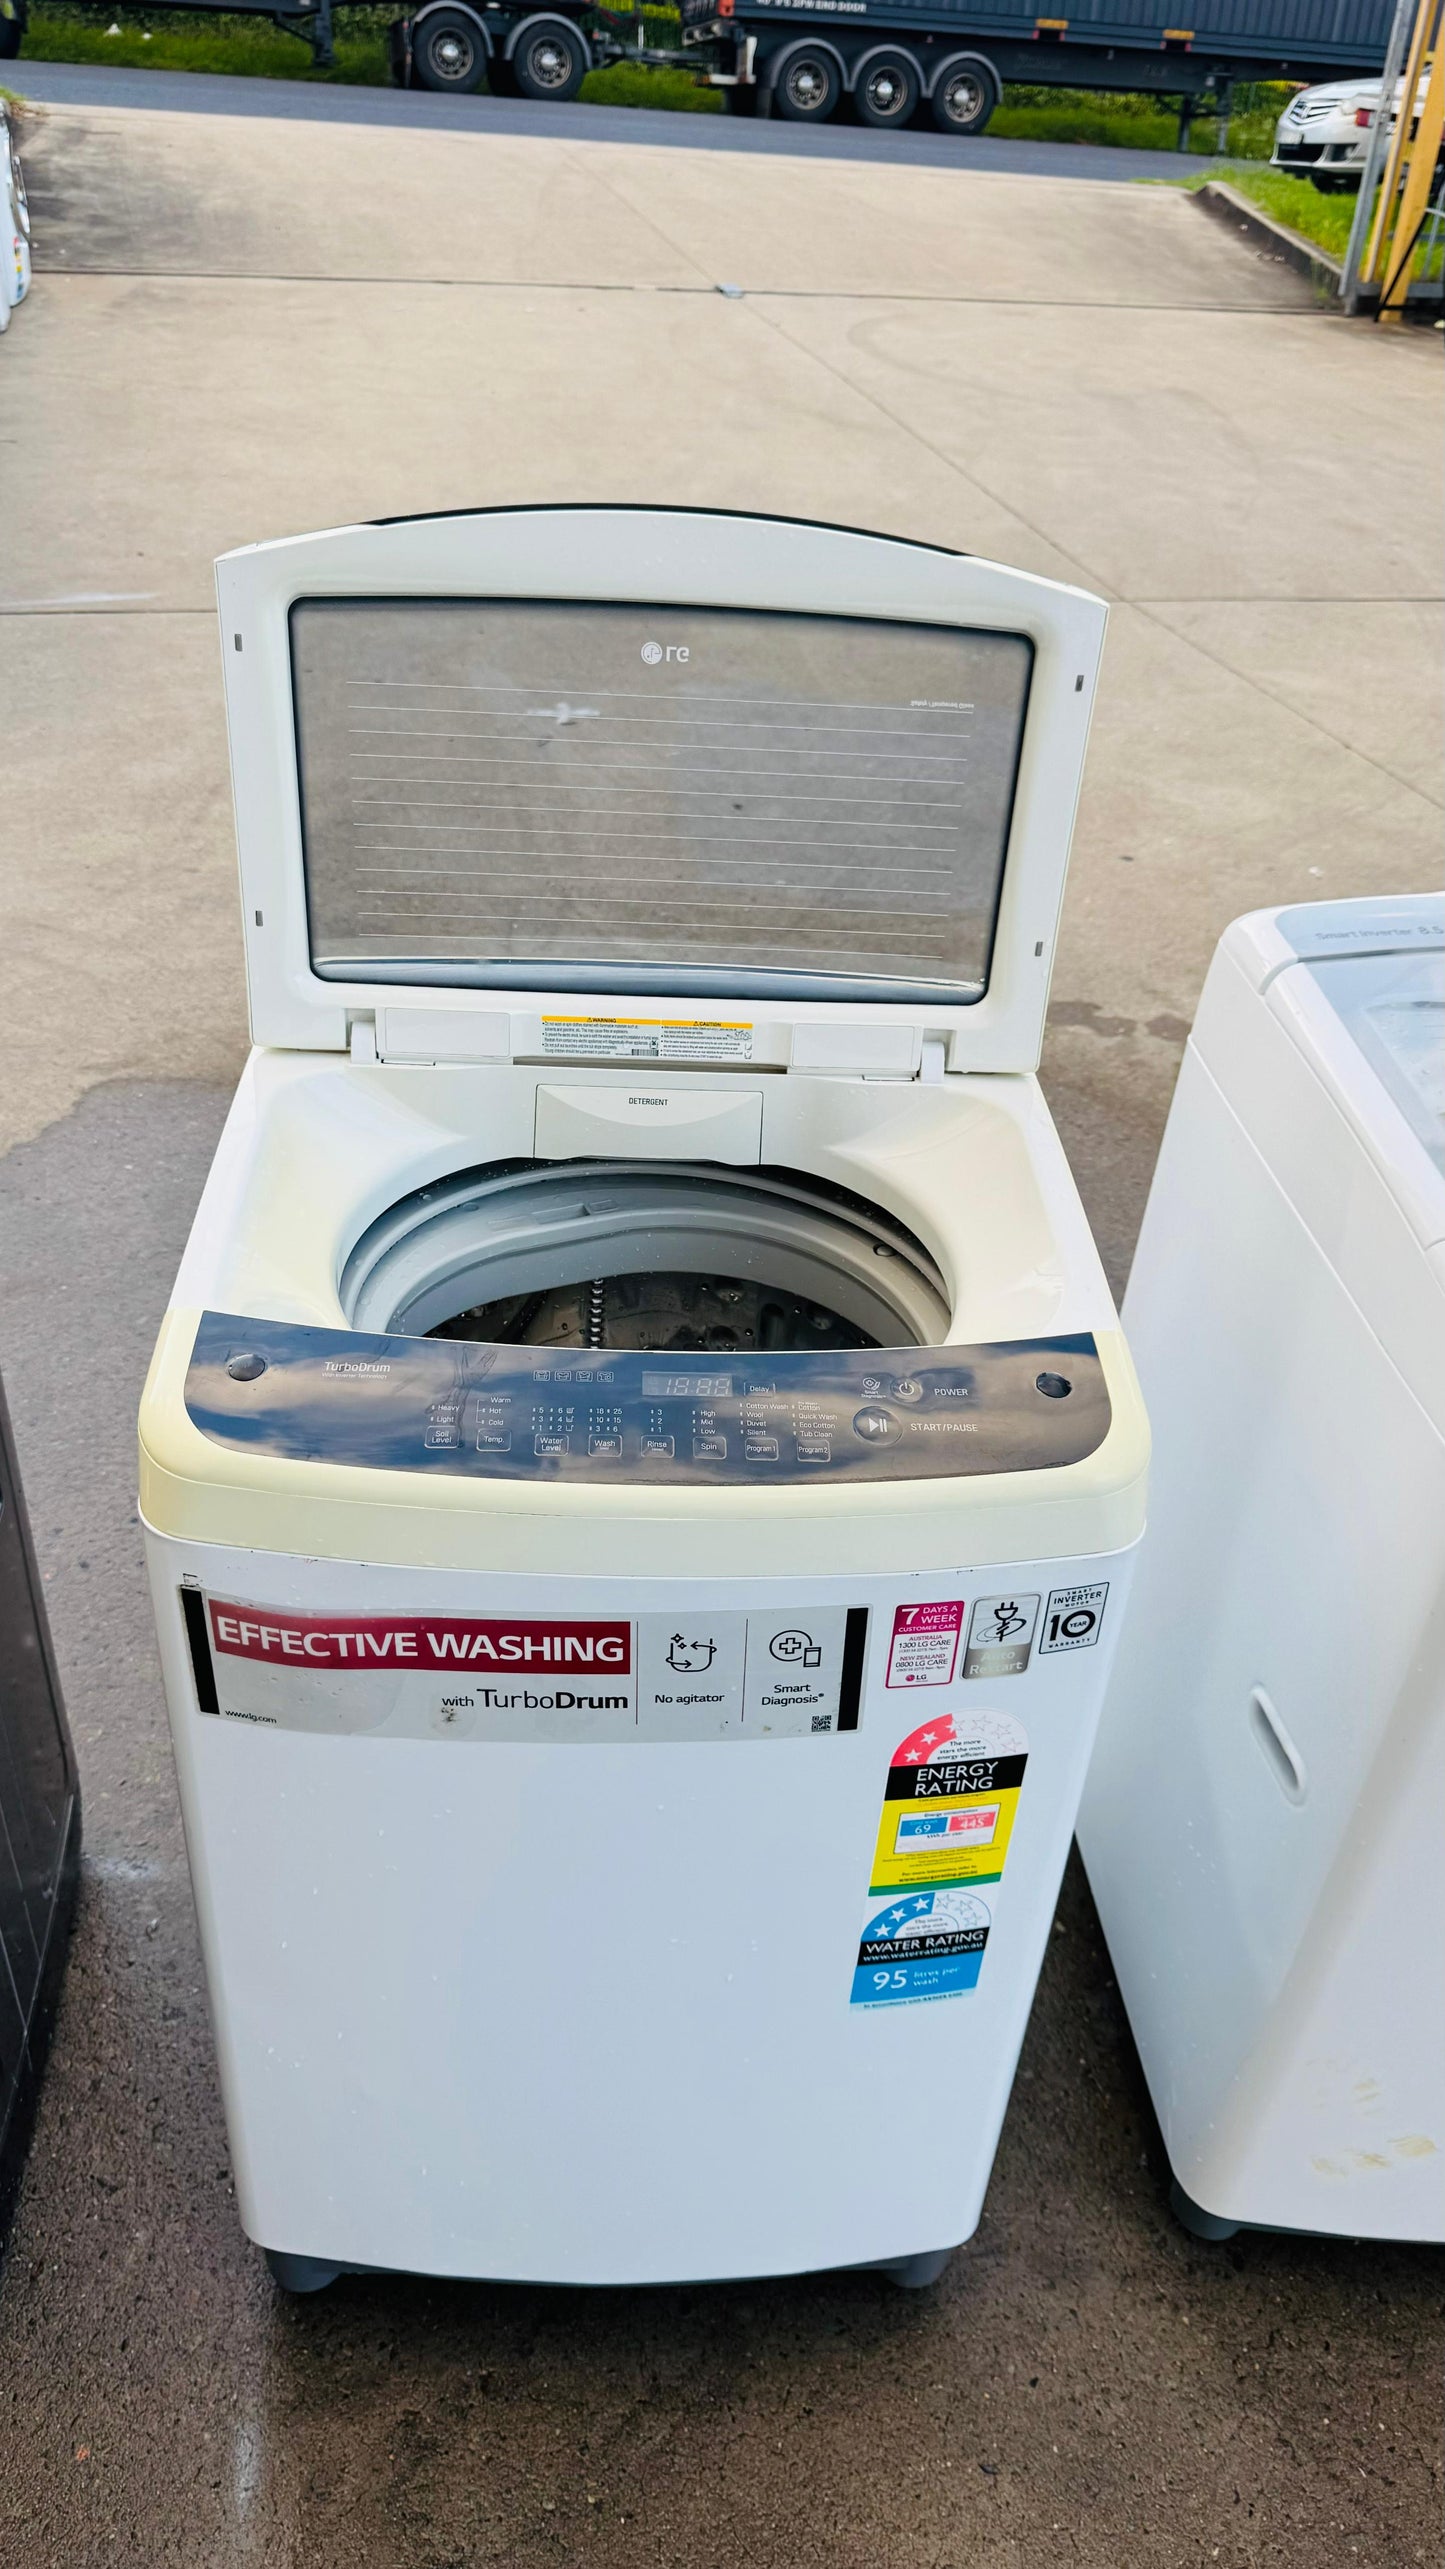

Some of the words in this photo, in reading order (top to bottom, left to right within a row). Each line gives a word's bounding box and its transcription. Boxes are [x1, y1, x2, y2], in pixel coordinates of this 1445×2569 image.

[628, 1097, 668, 1106] DETERGENT
[324, 1361, 391, 1372] TurboDrum
[749, 1385, 770, 1393] Delay
[934, 1388, 969, 1397] POWER
[798, 1403, 821, 1411] Cotton
[700, 1410, 716, 1418] High
[436, 1416, 454, 1424] Light
[799, 1421, 812, 1429] Eco
[910, 1423, 979, 1432] START/PAUSE
[431, 1436, 452, 1444] Level
[483, 1435, 505, 1444] Temp.
[647, 1440, 668, 1448] Rinse
[746, 1444, 772, 1453] Program
[798, 1446, 823, 1454] Program
[1054, 1591, 1102, 1604] INVERTER
[901, 1607, 920, 1625] 7
[923, 1605, 949, 1614] DAYS
[921, 1613, 957, 1624] WEEK
[898, 1625, 937, 1633] CUSTOMER
[1050, 1610, 1096, 1641] 10
[216, 1614, 419, 1658] EFFECTIVE
[426, 1633, 625, 1663] WASHING
[899, 1641, 916, 1649] 1300
[980, 1651, 1016, 1663] Ato
[969, 1661, 1023, 1675] Retart
[774, 1683, 812, 1693] Smart
[442, 1694, 475, 1708] with
[476, 1688, 629, 1710] TurboDrum
[654, 1694, 674, 1704] No
[676, 1693, 725, 1706] agitator
[225, 1710, 277, 1724] www.lg.com
[916, 1761, 998, 1782] ENERGY
[914, 1776, 993, 1796] RATING
[960, 1818, 985, 1829] 445
[914, 1824, 931, 1834] 69
[866, 1939, 921, 1954] WATER
[925, 1930, 984, 1947] RATING
[873, 1969, 908, 1991] 95
[913, 1977, 939, 1987] wash
